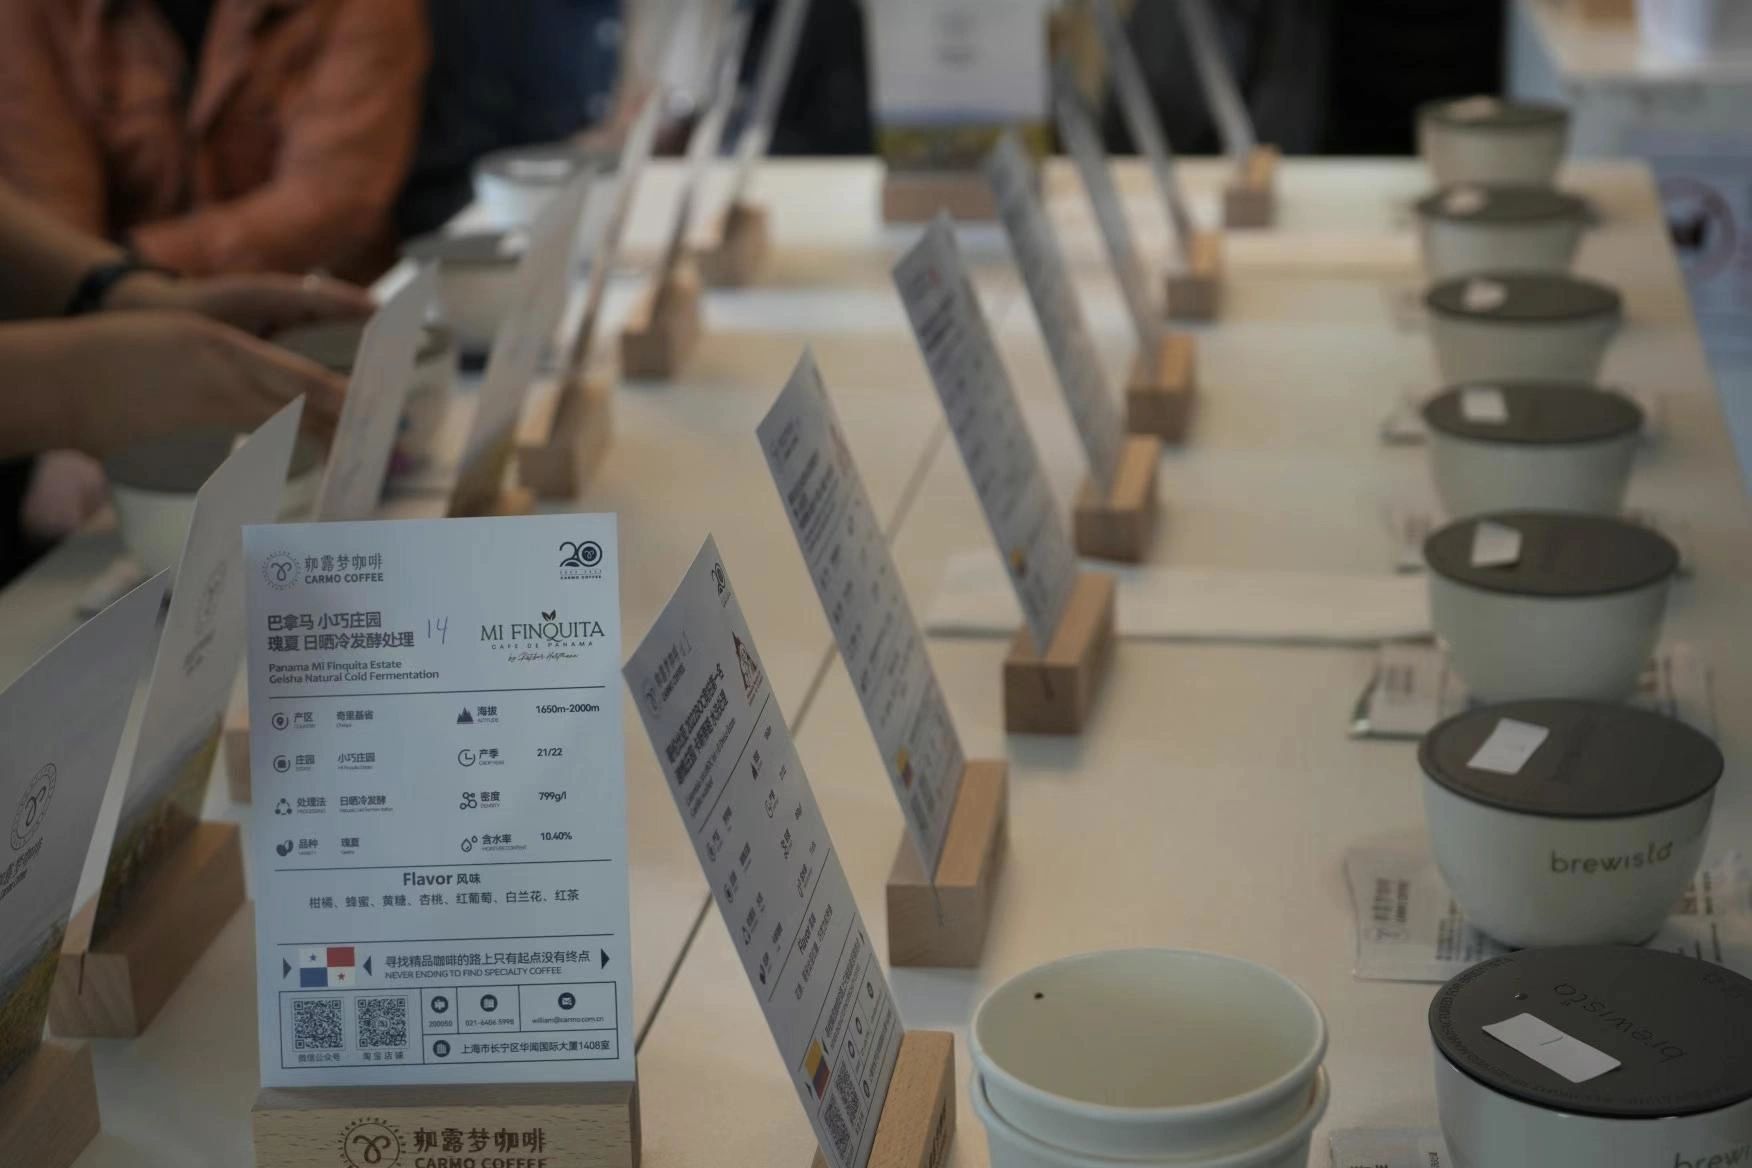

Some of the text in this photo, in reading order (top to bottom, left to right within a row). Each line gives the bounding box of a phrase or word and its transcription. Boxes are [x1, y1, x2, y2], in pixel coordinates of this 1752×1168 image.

[559, 540, 603, 568] 20
[304, 572, 384, 585] CARMO COFFEE
[267, 611, 382, 631] 巴拿马 小巧庄园
[427, 615, 449, 645] 14
[480, 621, 606, 642] MI FINQUITA
[267, 631, 415, 652] 瑰夏 日晒冷发酵处理
[269, 659, 402, 674] Panama Mi Finquita Estate
[269, 668, 440, 684] Geisha Natural Cold Fermentation
[536, 703, 600, 715] 1650m-2000m
[294, 712, 314, 723] 产区
[338, 752, 376, 764] 小巧庄园
[537, 747, 563, 757] 21/22
[295, 754, 316, 765] 庄园
[297, 797, 327, 808] 处理法
[340, 795, 386, 807] 日晒冷发酵
[480, 791, 500, 802] 密度
[481, 834, 512, 845] 含水率
[540, 831, 572, 841] 10.40%
[298, 838, 319, 850] 品种
[403, 871, 481, 886] Flavor 风味
[385, 950, 590, 969] 寻找精品咖啡的路上只有起点没有终点
[385, 966, 562, 979] NEVER ENDING TO FIND SPECIALTY COFFEE
[414, 1155, 547, 1168] CARMO COFFEE
